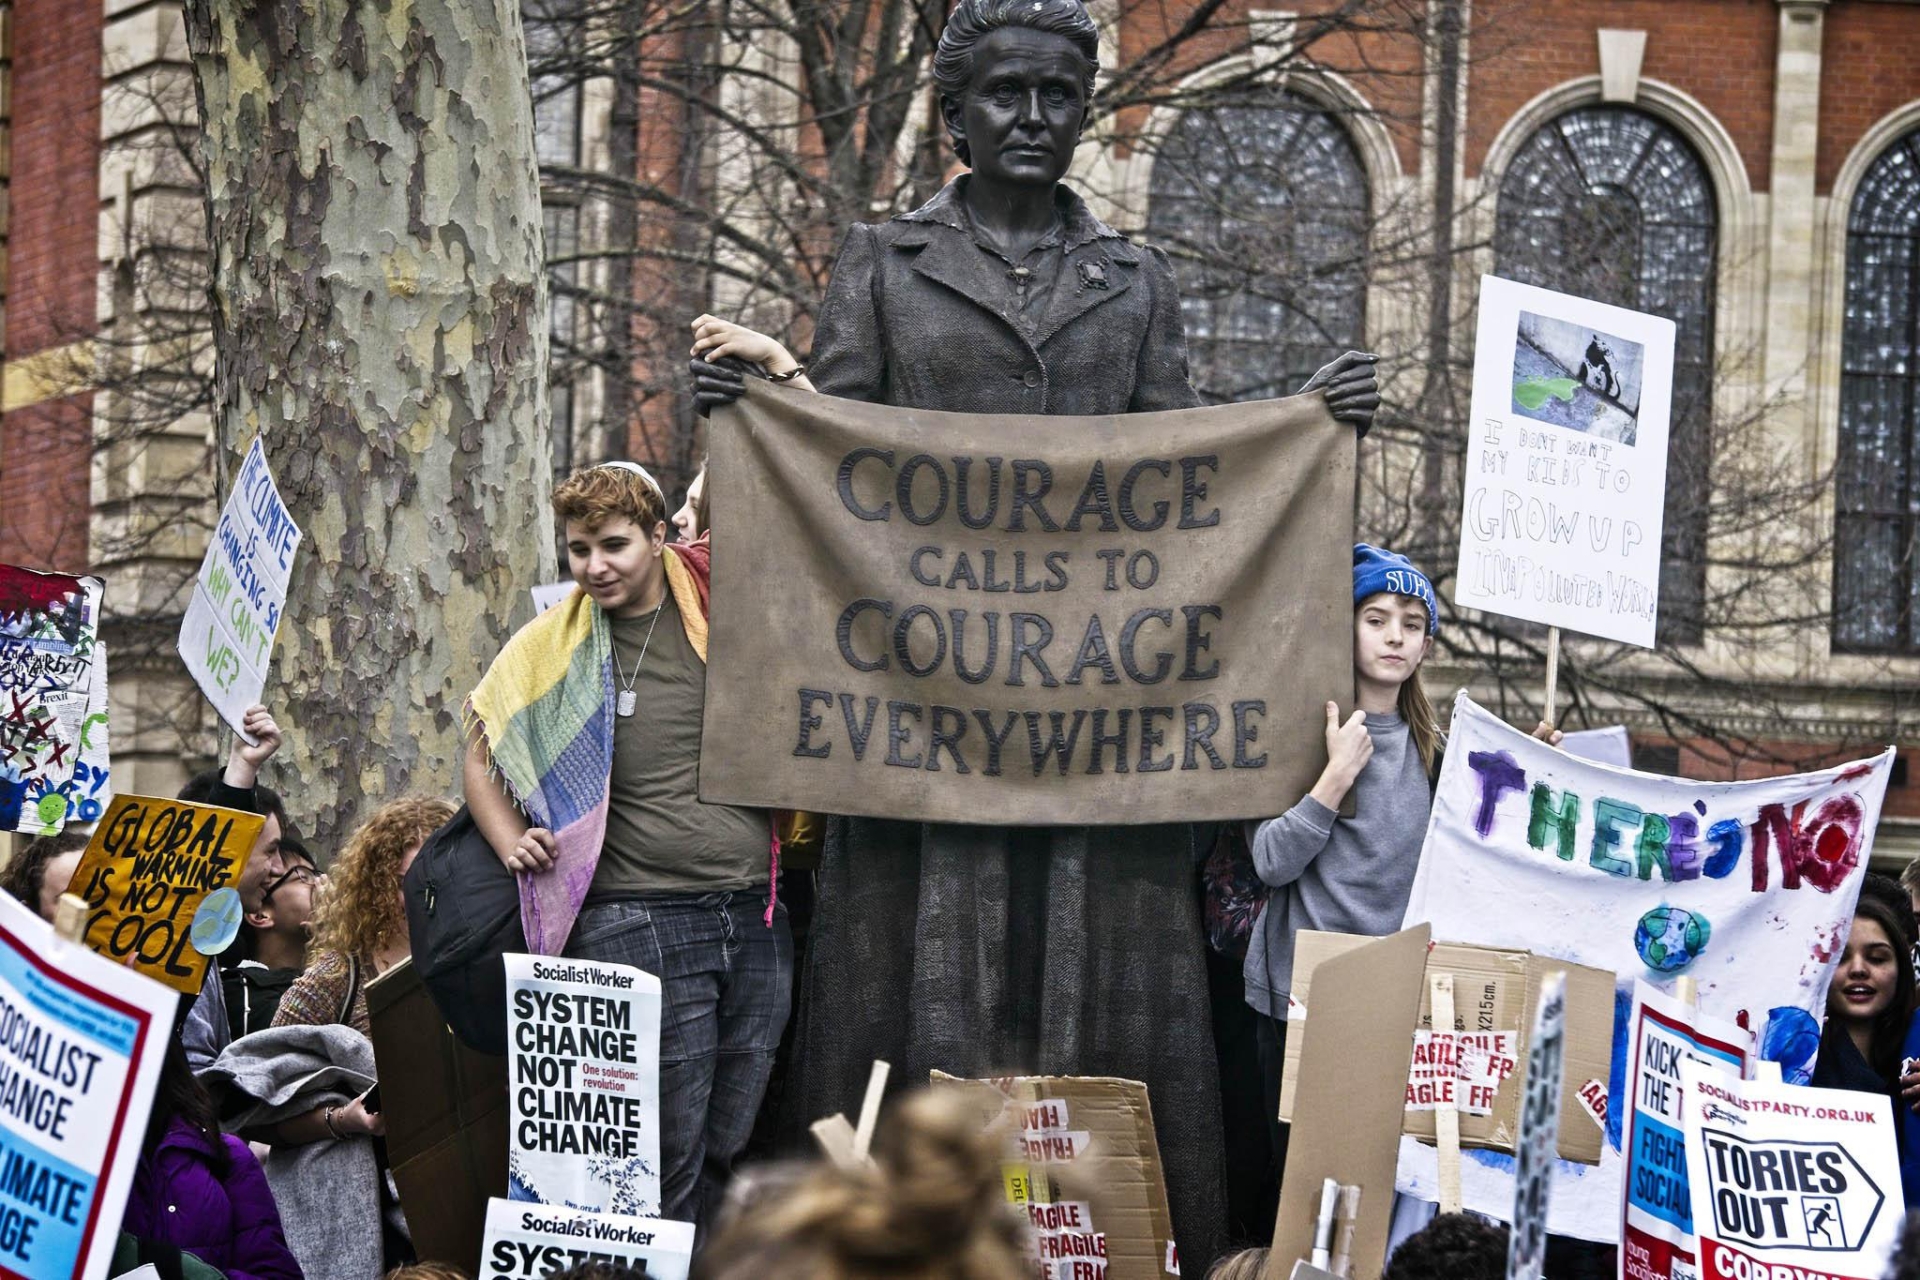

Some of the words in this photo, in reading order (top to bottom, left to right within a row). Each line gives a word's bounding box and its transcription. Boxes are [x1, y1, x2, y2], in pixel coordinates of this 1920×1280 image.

[1484, 419, 1502, 445] I
[1567, 440, 1612, 460] WANT
[240, 439, 263, 501] THE
[837, 447, 1221, 532] COURAGE
[1481, 450, 1508, 475] MY
[1527, 456, 1586, 487] KIDS
[1596, 461, 1631, 493] TO
[247, 528, 259, 559] IS
[251, 475, 296, 571] CLIMATE
[1469, 487, 1579, 544] GROW
[1589, 515, 1642, 556] UP
[219, 514, 266, 611] CHANGING
[265, 602, 279, 635] SO
[910, 546, 1069, 592] CALLS
[1097, 549, 1160, 590] TO
[207, 551, 232, 601] WHY
[231, 598, 268, 667] CAN'T
[205, 625, 240, 697] WE?
[836, 598, 1222, 687] COURAGE
[792, 688, 1268, 777] EVERYWHERE
[103, 803, 234, 867] GLOBAL
[1751, 792, 1866, 893] NO
[83, 867, 115, 910] IS
[119, 881, 198, 920] NOT
[129, 851, 232, 892] WARMING
[83, 910, 194, 977] COOL
[533, 962, 589, 984] Socialist
[590, 969, 634, 989] Worker
[514, 988, 631, 1030] SYSTEM
[0, 996, 102, 1094] OCIALIST
[515, 1022, 637, 1064] CHANGE
[1645, 1034, 1682, 1080] KICK
[517, 1054, 577, 1088] NOT
[583, 1063, 600, 1075] One
[602, 1067, 639, 1081] solution:
[583, 1077, 625, 1092] revolution
[518, 1087, 641, 1129] CLIMATE
[1643, 1072, 1671, 1116] THE
[1698, 1081, 1876, 1124] SOCIALISTPARTY.ORG.UK
[1712, 1104, 1747, 1125] Socialist
[518, 1120, 638, 1159] CHANGE
[1709, 1110, 1736, 1126] Party
[1708, 1138, 1847, 1194] TORIES
[521, 1212, 592, 1238] Socialist
[594, 1222, 655, 1246] Worker
[1717, 1188, 1788, 1239] OUT
[1039, 1234, 1106, 1259] FRAGILE
